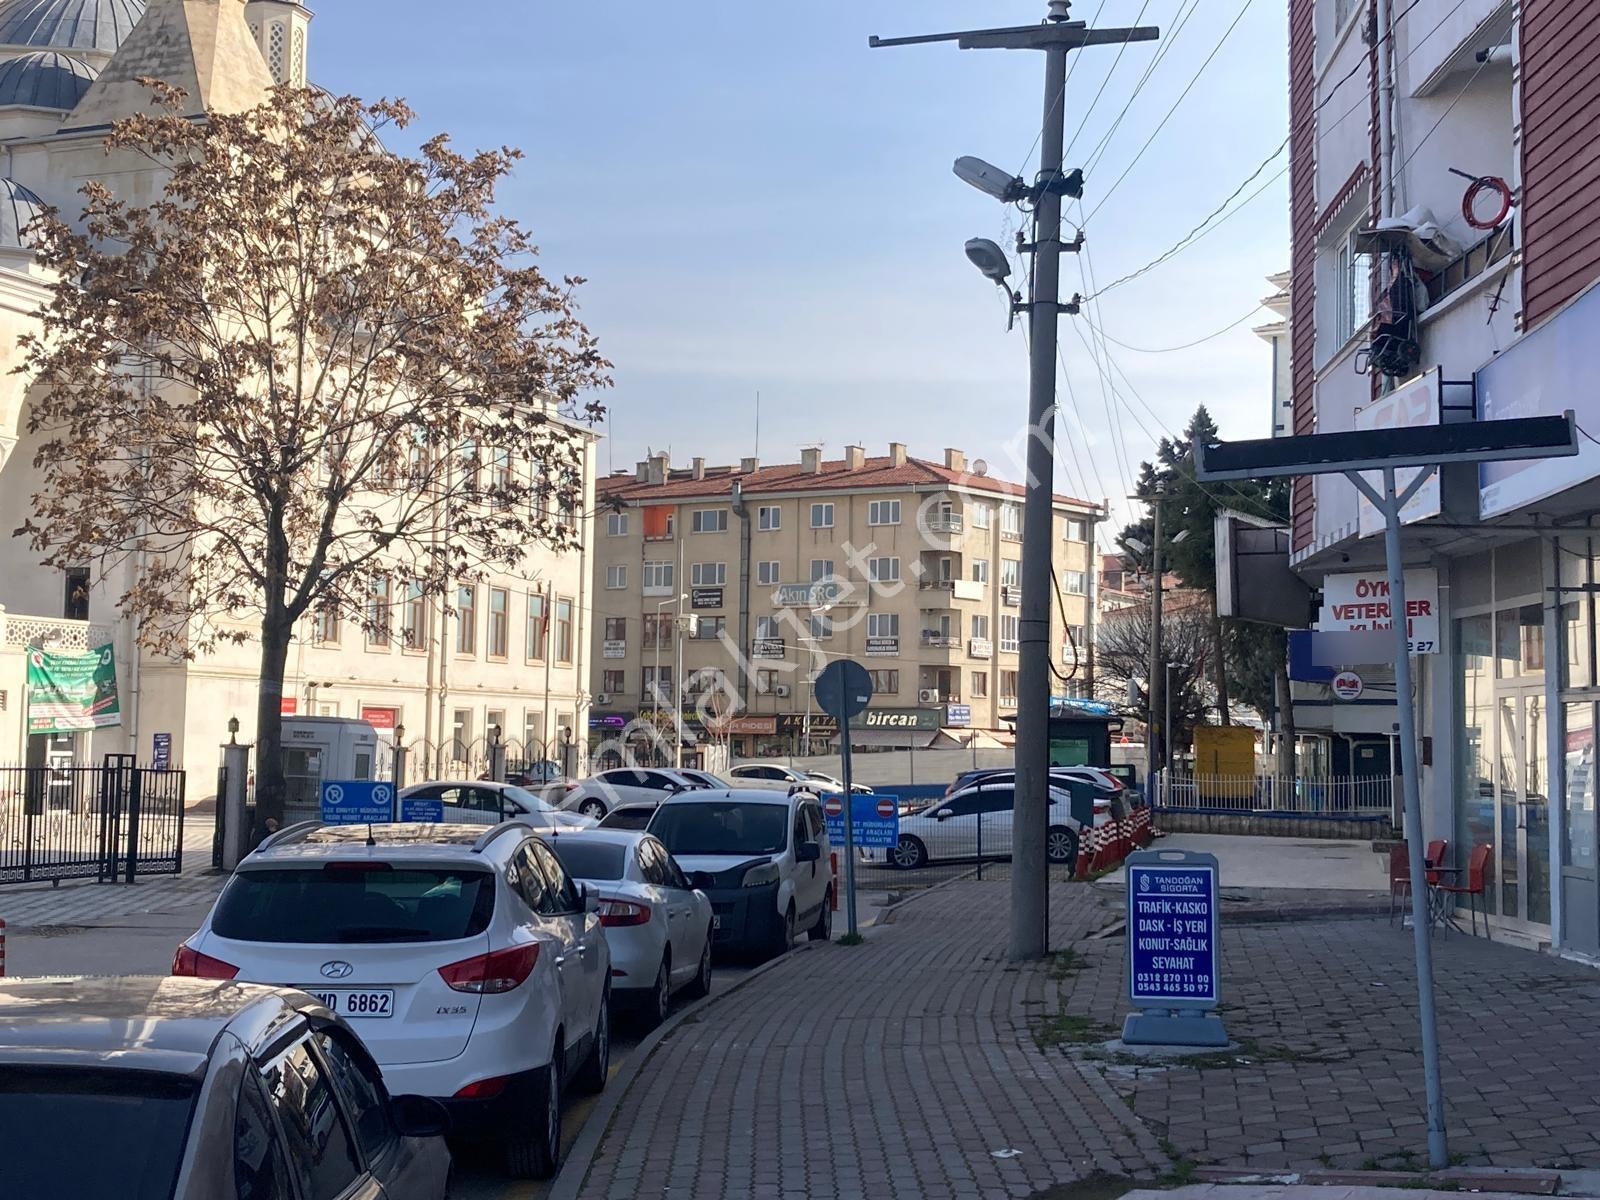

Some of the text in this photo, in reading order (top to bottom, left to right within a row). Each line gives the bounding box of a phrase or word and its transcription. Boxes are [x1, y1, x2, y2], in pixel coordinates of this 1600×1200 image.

[809, 586, 834, 601] SRC
[1355, 579, 1390, 598] ÖYK
[1417, 641, 1433, 651] 27
[866, 711, 918, 726] bircan
[1154, 876, 1203, 885] TANDOĞAN
[1160, 884, 1198, 893] SİGORTA
[1138, 899, 1207, 915] TRAFİK-KASKO
[1139, 919, 1165, 932] DASK
[1174, 918, 1183, 935] İŞ
[1185, 918, 1207, 933] YERİ
[1139, 937, 1208, 951] KONUT-SAĞLIK
[1152, 956, 1195, 970] SEYAHAT
[1138, 973, 1209, 983] 0312 270 11 00
[1138, 982, 1161, 992] 0543
[1184, 983, 1195, 992] 50
[1197, 984, 1209, 993] 97
[348, 994, 390, 1013] 6862
